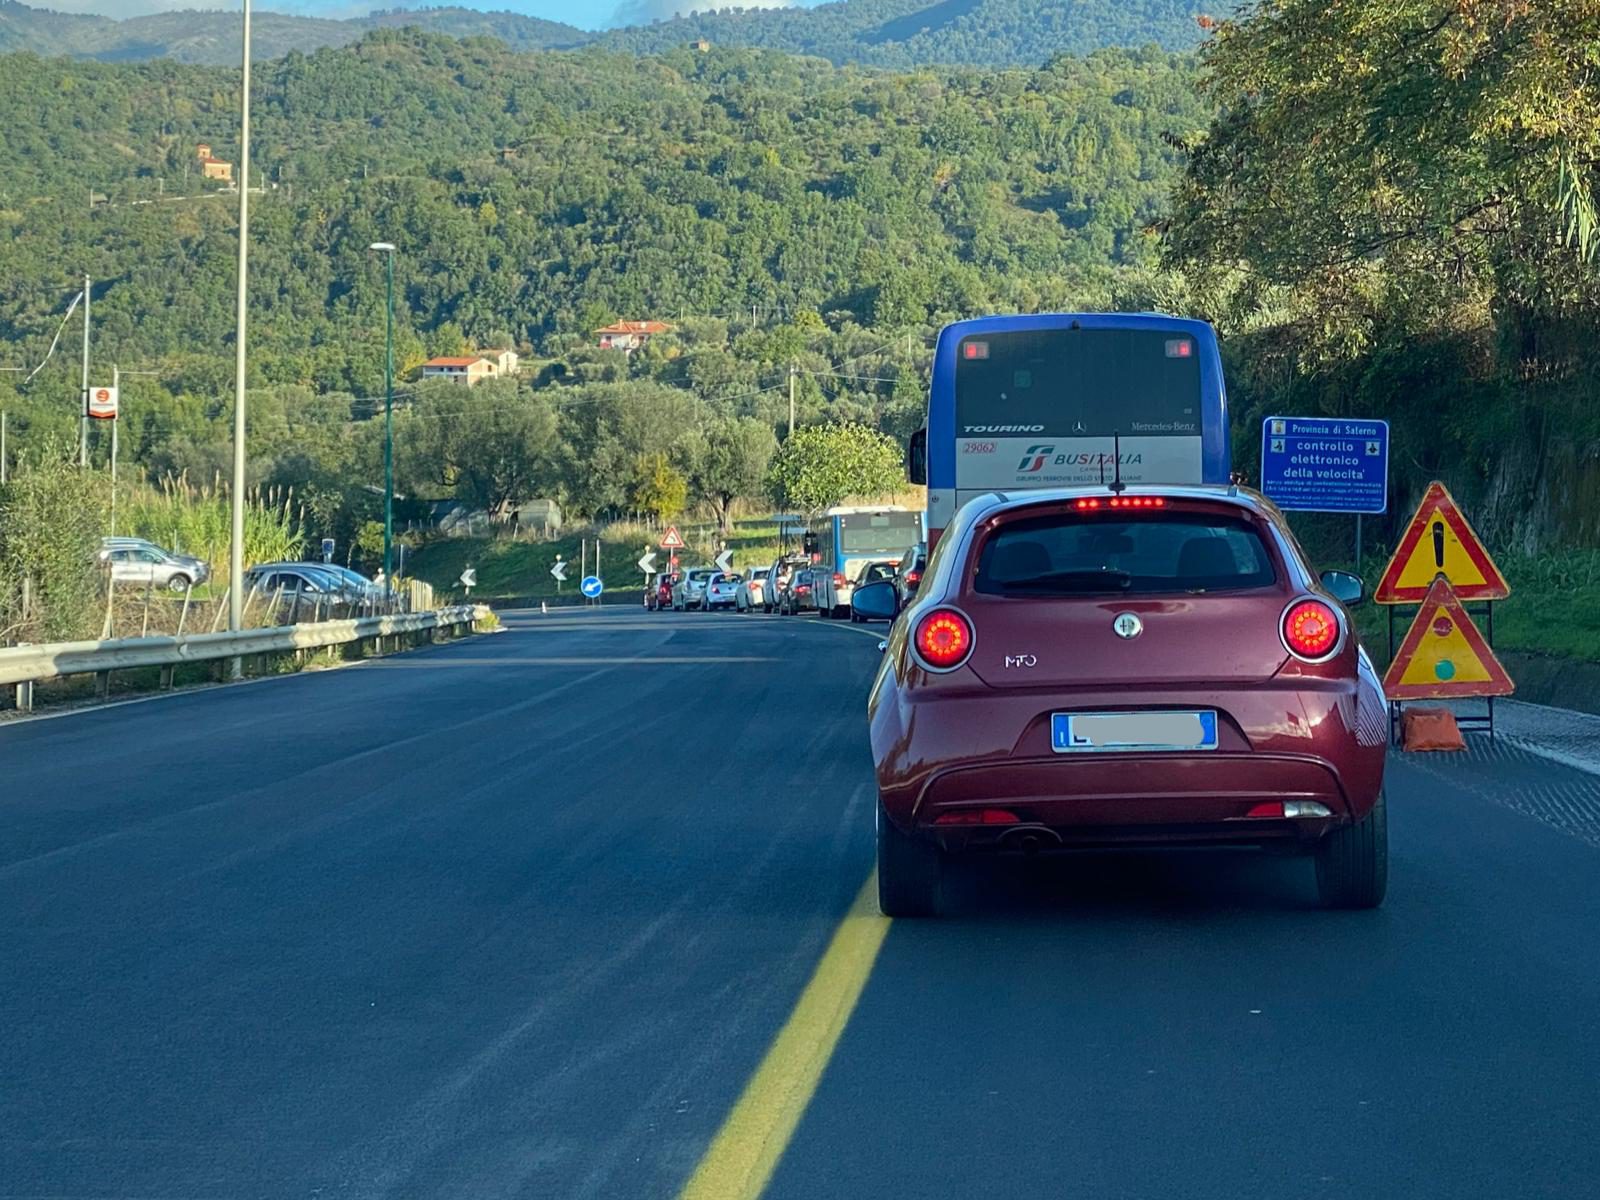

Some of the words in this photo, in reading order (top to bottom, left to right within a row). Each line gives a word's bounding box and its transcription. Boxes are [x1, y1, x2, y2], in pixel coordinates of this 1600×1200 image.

[963, 424, 1045, 433] TOURINO
[1131, 422, 1195, 432] Mercedes-Benz
[1292, 424, 1329, 434] Provincia
[1333, 425, 1341, 434] di
[1345, 425, 1377, 435] Salerno
[963, 442, 996, 454] 29062
[1297, 441, 1354, 452] controllo
[1054, 453, 1142, 465] BUSITALIA
[1290, 454, 1359, 466] elettronico
[1283, 467, 1313, 478] della
